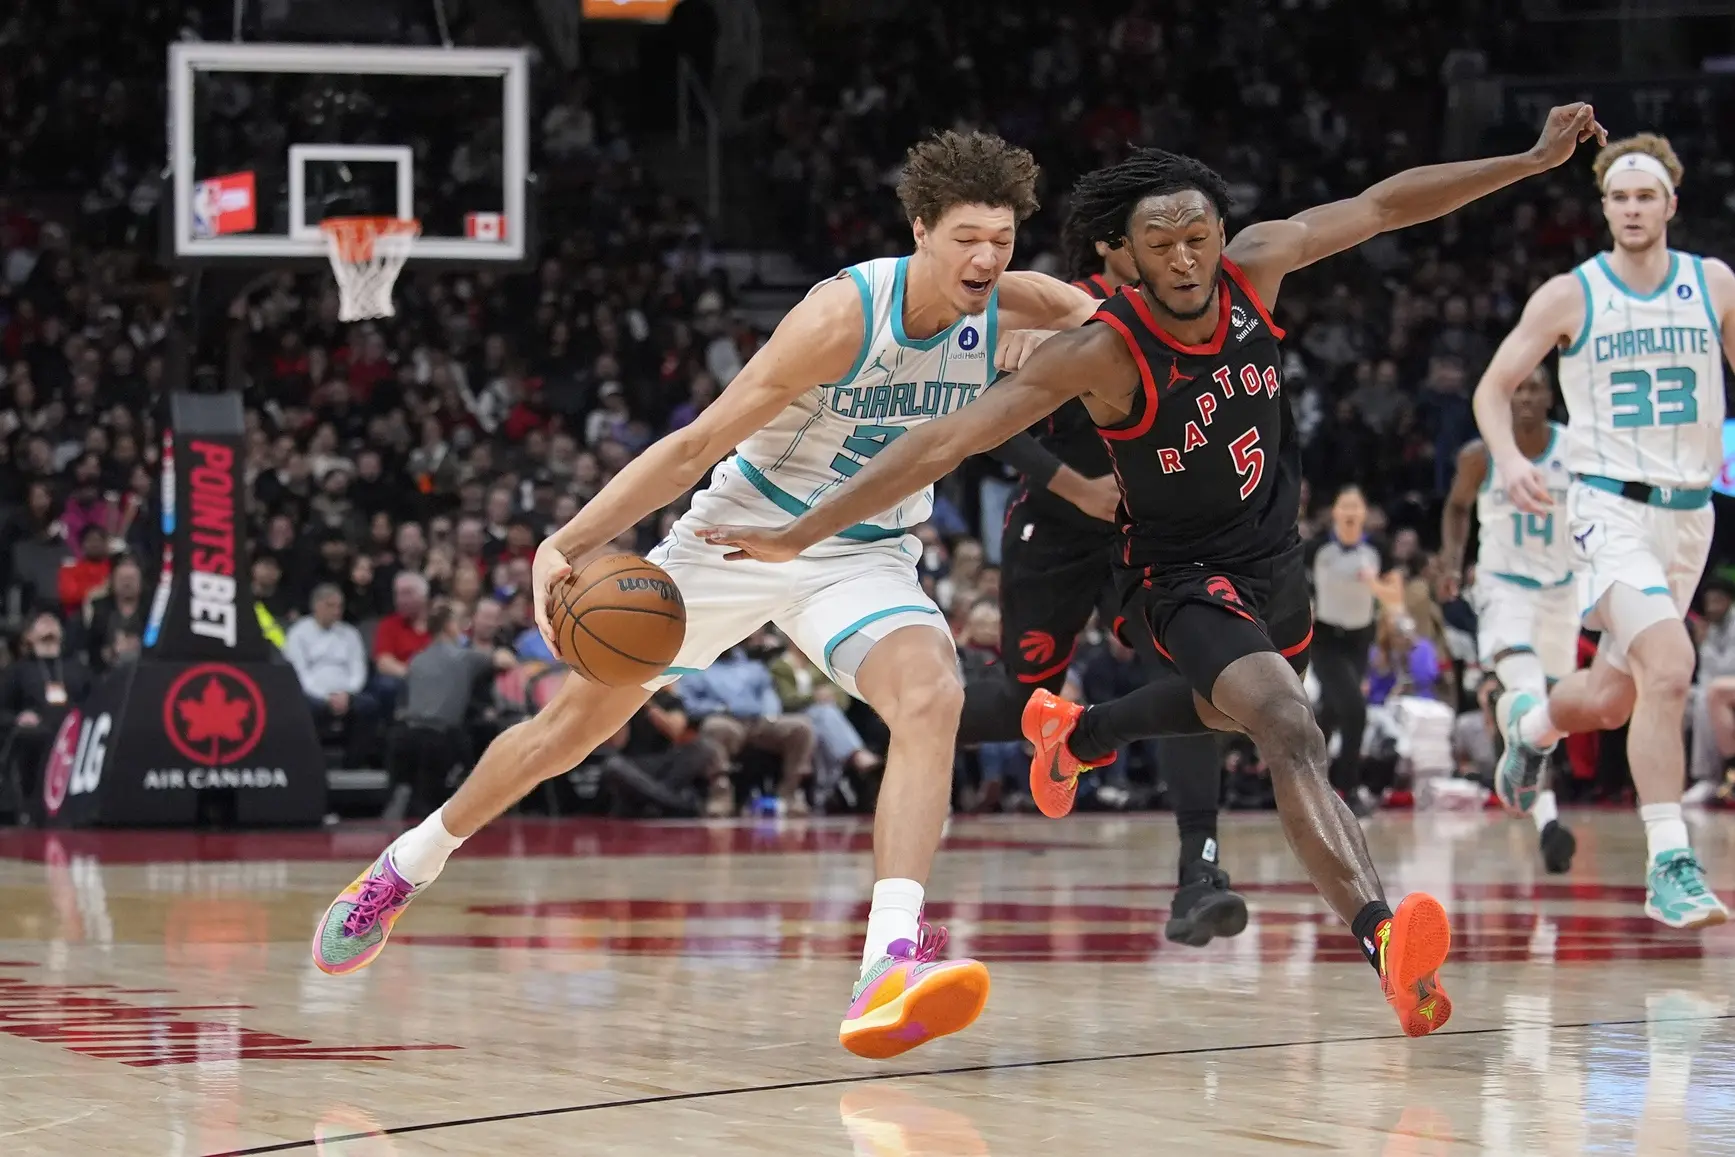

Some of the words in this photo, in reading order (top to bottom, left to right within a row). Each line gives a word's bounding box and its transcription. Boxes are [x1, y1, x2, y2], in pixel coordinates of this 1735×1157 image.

[1235, 328, 1250, 343] Sun
[1245, 318, 1260, 332] Life
[1594, 326, 1709, 363] CHARLOTTE
[1156, 363, 1281, 475] RAPTOR
[1610, 366, 1698, 428] 33
[1228, 426, 1264, 500] 5
[189, 440, 237, 648] POINTSBET
[1510, 511, 1554, 547] 14
[69, 712, 112, 796] LG
[143, 767, 186, 790] AIR
[187, 766, 288, 790] CANADA
